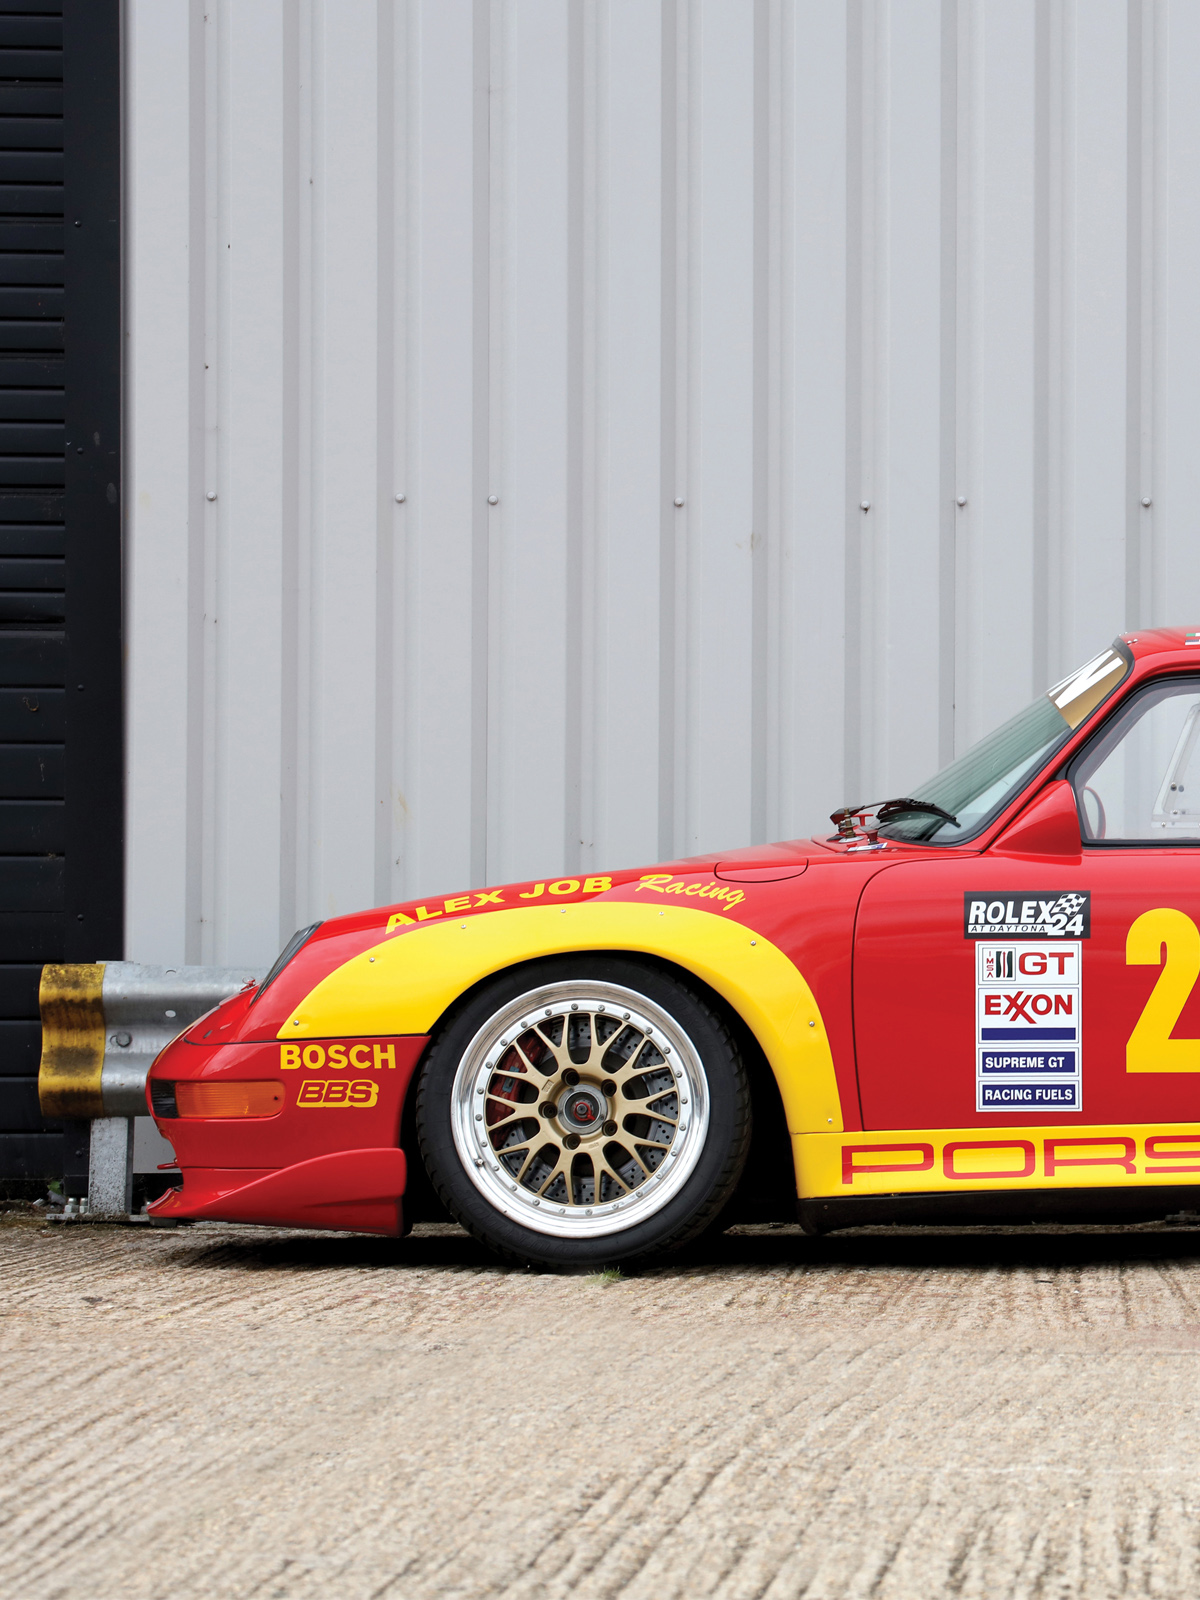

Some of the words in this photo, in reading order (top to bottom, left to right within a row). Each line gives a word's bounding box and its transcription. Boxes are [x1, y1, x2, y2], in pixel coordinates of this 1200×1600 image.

[385, 889, 506, 935] ALEX
[519, 876, 613, 899] JOB
[635, 873, 746, 911] Racing
[968, 901, 1056, 924] ROLEX
[1047, 913, 1084, 936] 24
[1018, 952, 1074, 976] GT
[984, 991, 1073, 1024] EXXON
[280, 1044, 396, 1069] BOSCH
[985, 1056, 1044, 1068] SUPREME
[1048, 1056, 1065, 1068] GT
[296, 1080, 379, 1107] BBS
[985, 1089, 1032, 1101] RACING
[1036, 1089, 1073, 1101] FUELS
